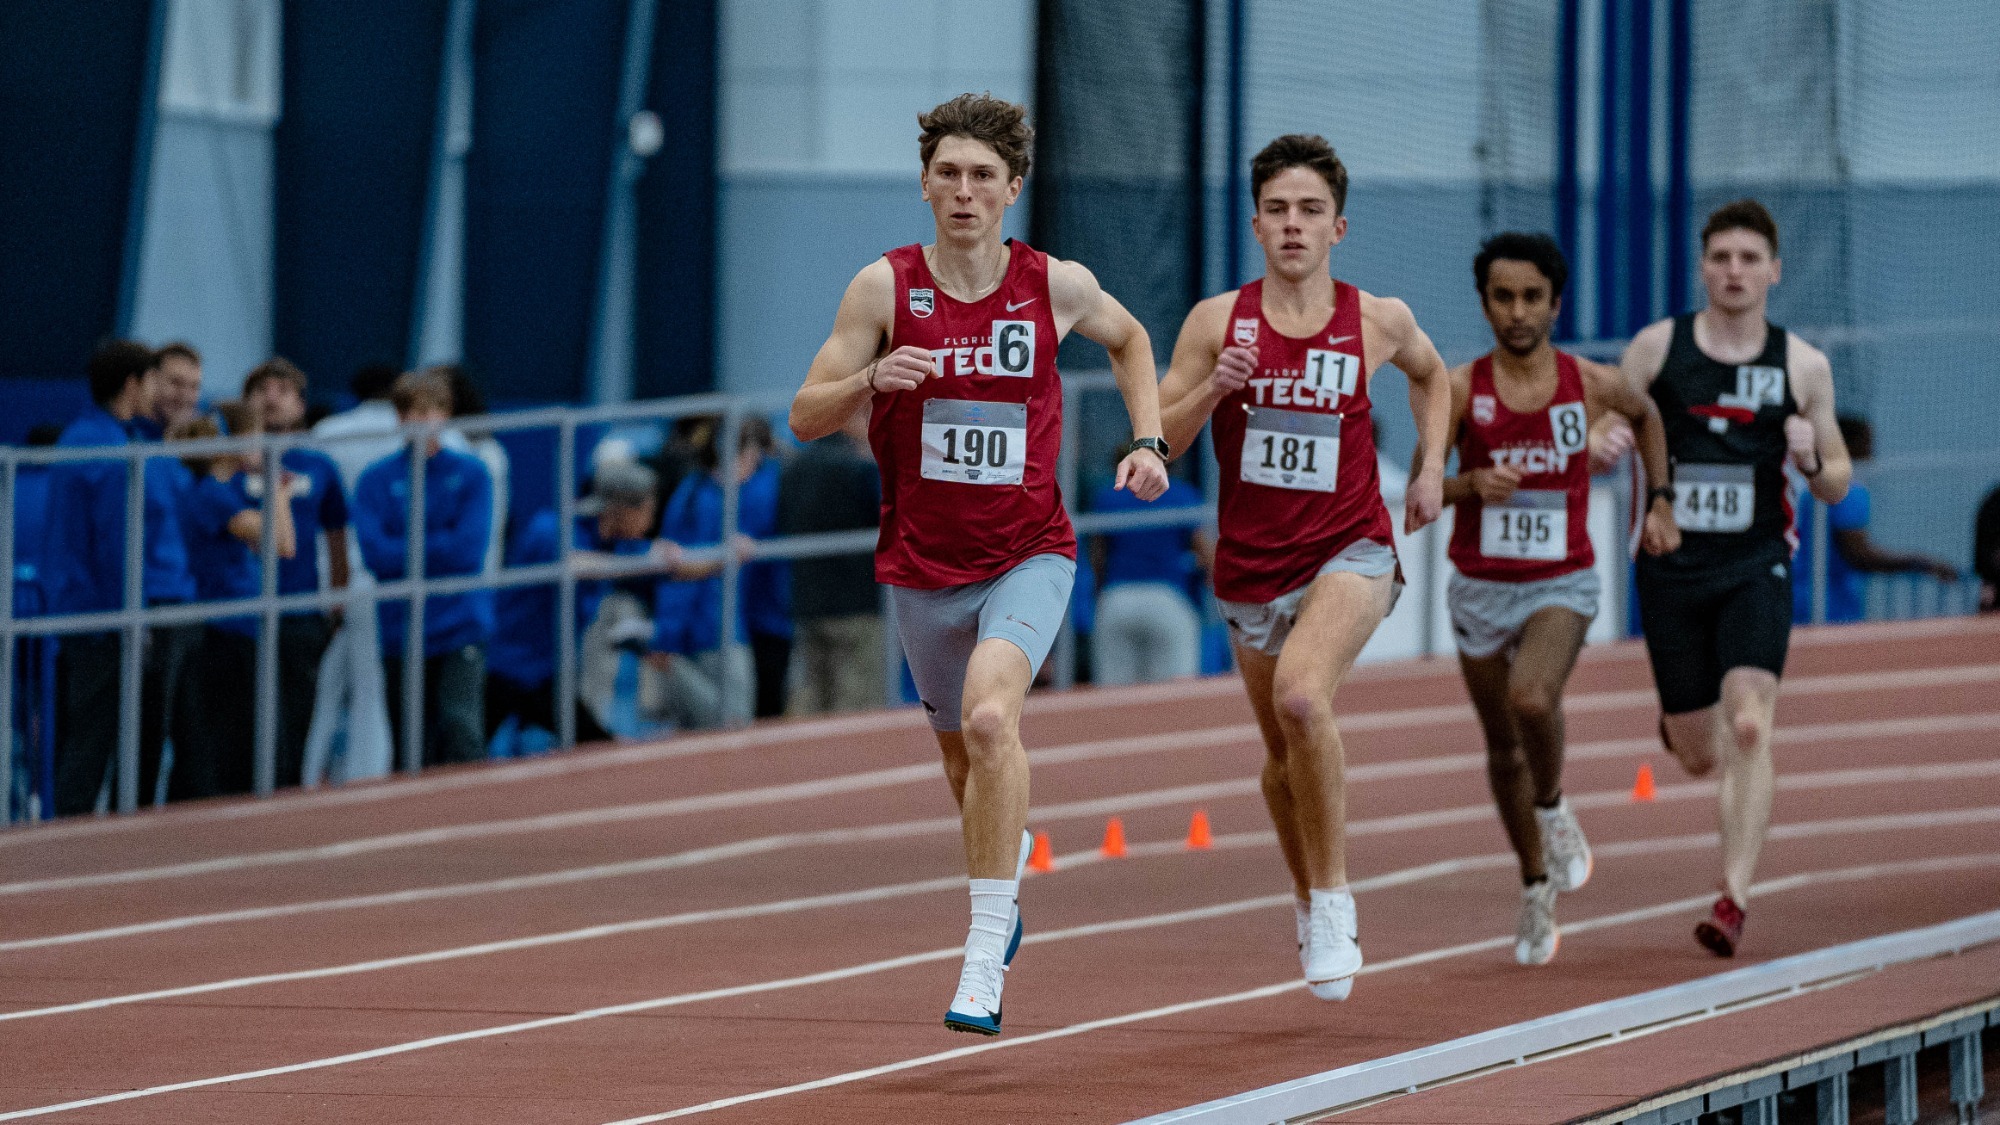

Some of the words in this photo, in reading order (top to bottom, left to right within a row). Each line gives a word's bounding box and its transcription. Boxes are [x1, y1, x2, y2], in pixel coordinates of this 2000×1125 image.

[944, 336, 993, 346] FLORID
[998, 323, 1030, 373] 6
[929, 346, 993, 378] TEC
[1264, 368, 1304, 377] FLORI
[1312, 353, 1346, 391] 11
[1248, 377, 1340, 410] TECH
[1745, 371, 1776, 403] 12
[1559, 409, 1582, 447] 8
[942, 428, 1007, 468] 190
[1260, 435, 1317, 474] 181
[1685, 487, 1738, 515] 448
[1499, 513, 1550, 543] 195
